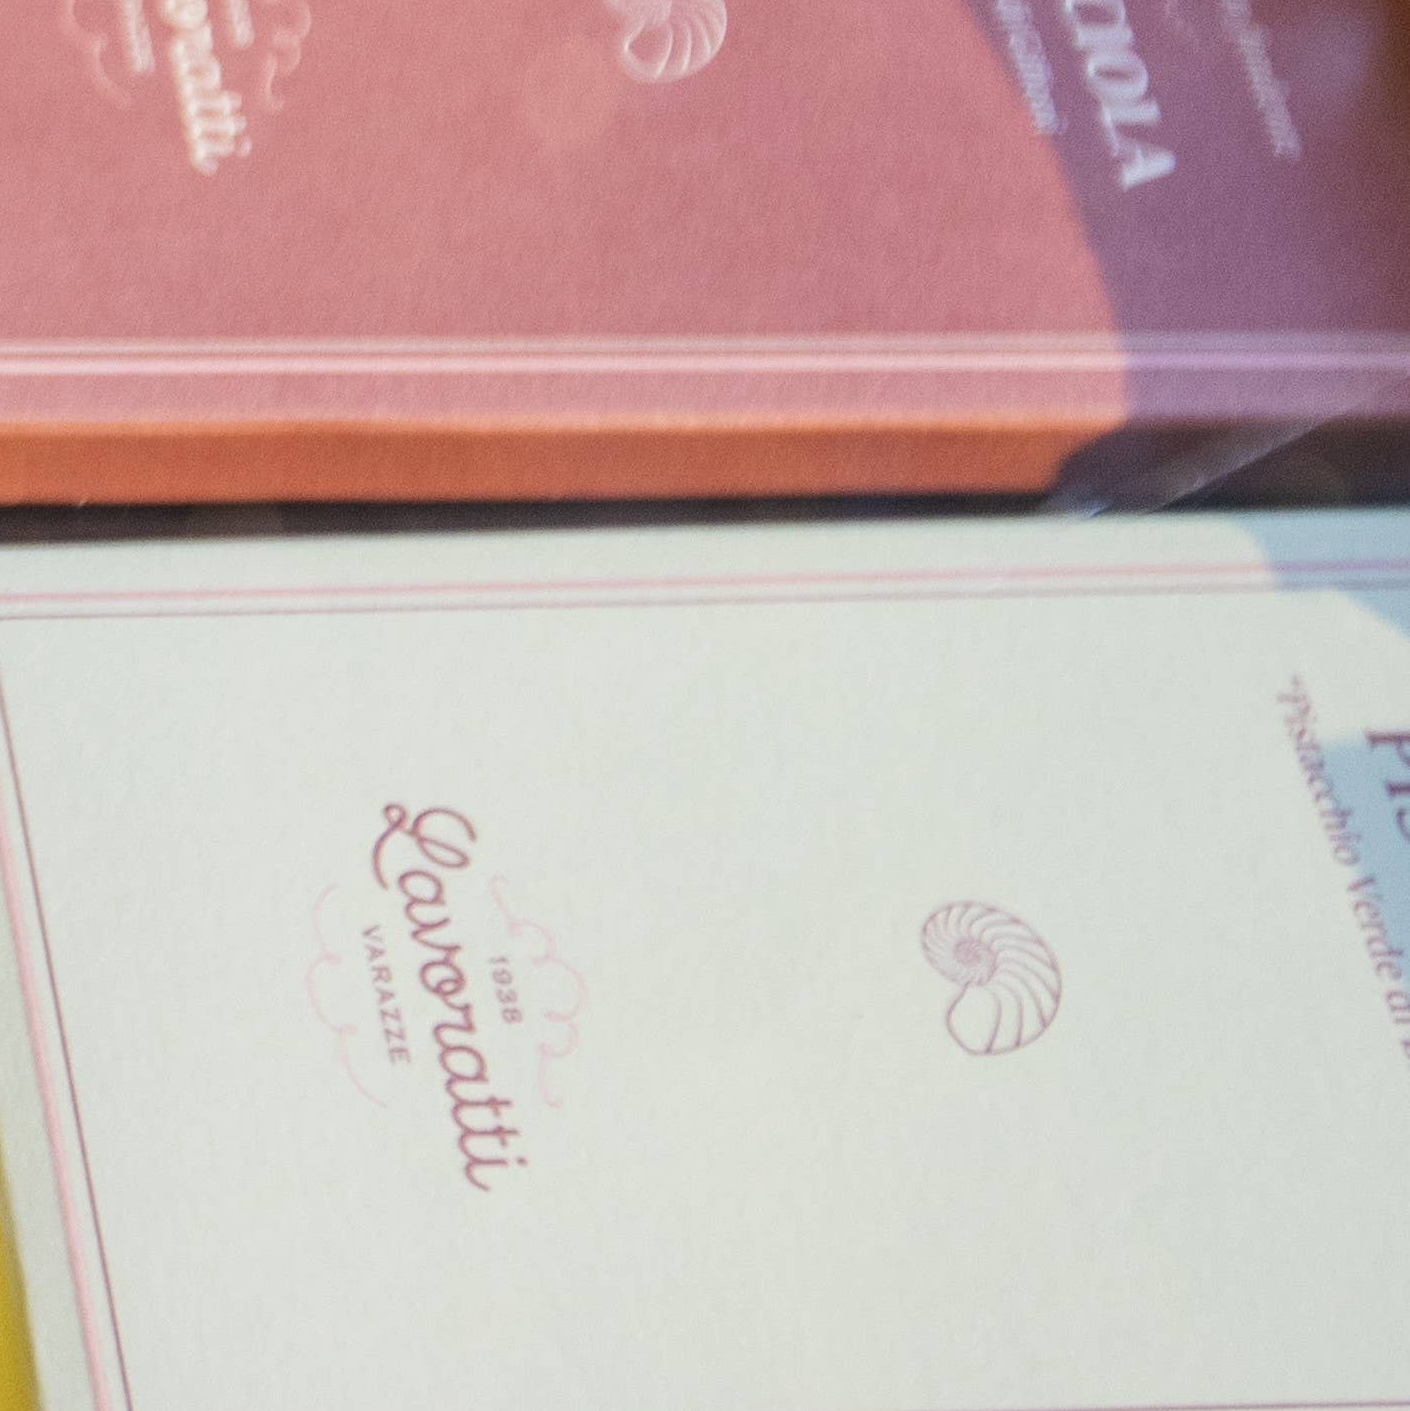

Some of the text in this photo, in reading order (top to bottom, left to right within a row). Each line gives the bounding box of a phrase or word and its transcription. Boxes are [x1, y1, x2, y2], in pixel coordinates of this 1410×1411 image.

[362, 924, 411, 1066] VARAZZE
[371, 802, 528, 1192] Lavoratti
[489, 955, 523, 1024] 1938
